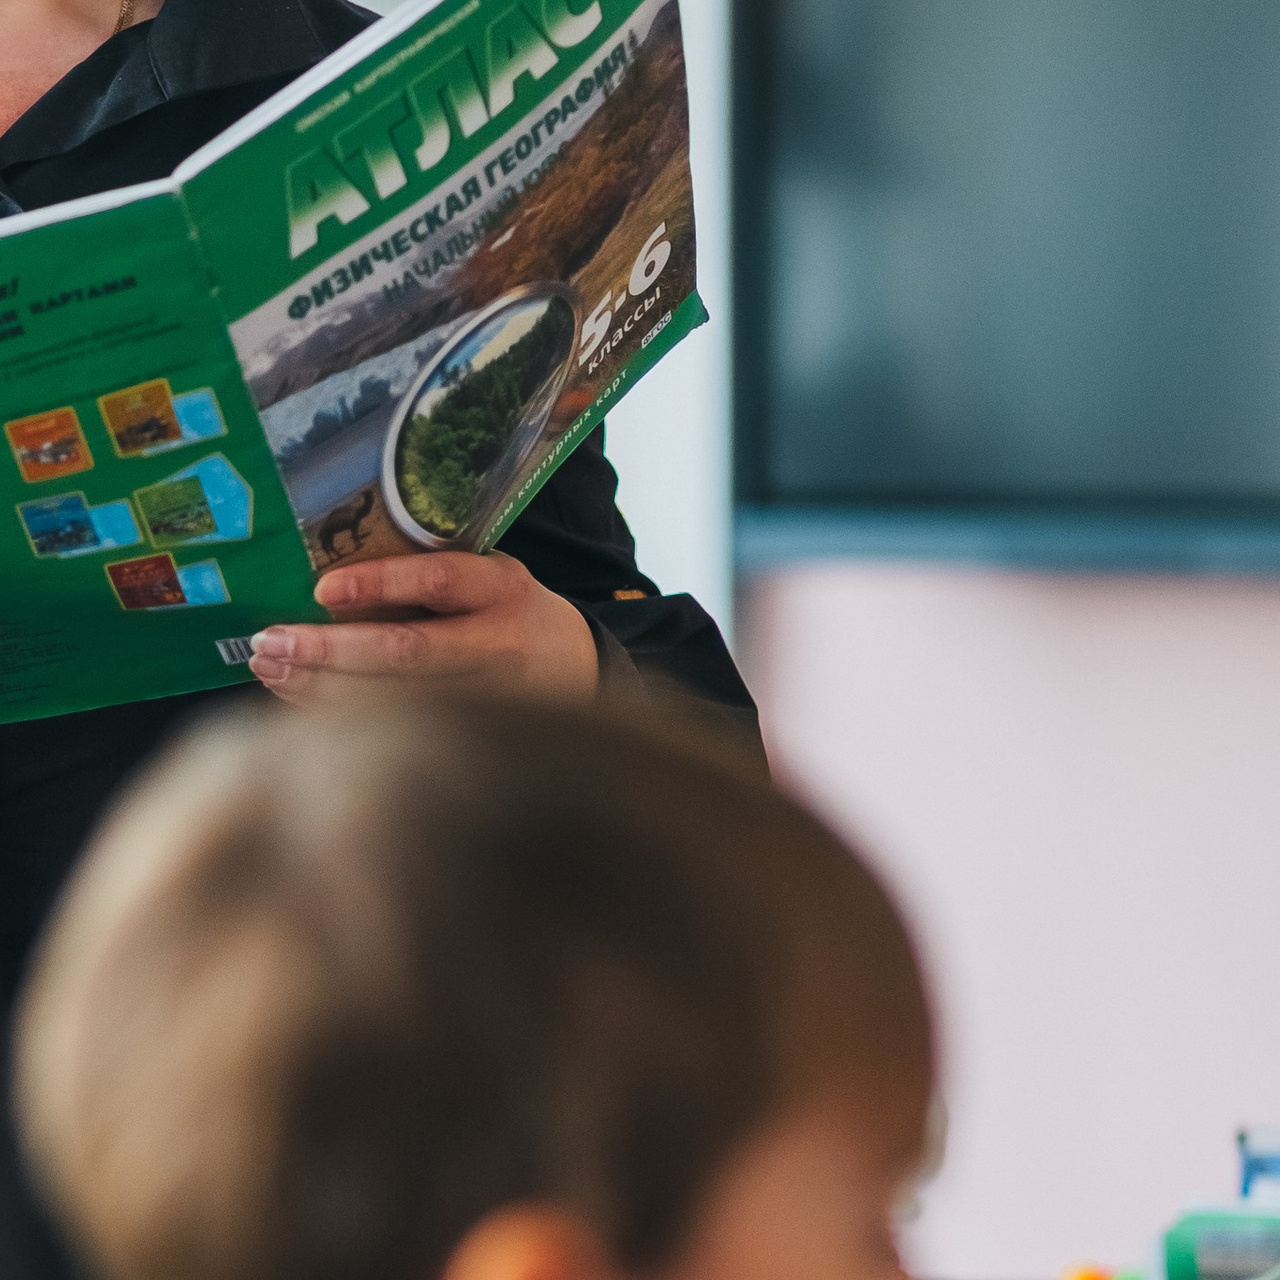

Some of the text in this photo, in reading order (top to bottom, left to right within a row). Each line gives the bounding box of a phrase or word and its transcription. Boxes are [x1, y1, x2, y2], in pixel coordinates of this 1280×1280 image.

[287, 175, 482, 321] ФИЗИЧЕСКАЯ
[483, 38, 629, 188] ГЕОГРАФИЯ
[29, 274, 138, 316] КАРТАМИ
[588, 286, 662, 375] классы
[517, 408, 592, 499] контурных
[596, 368, 628, 407] карт
